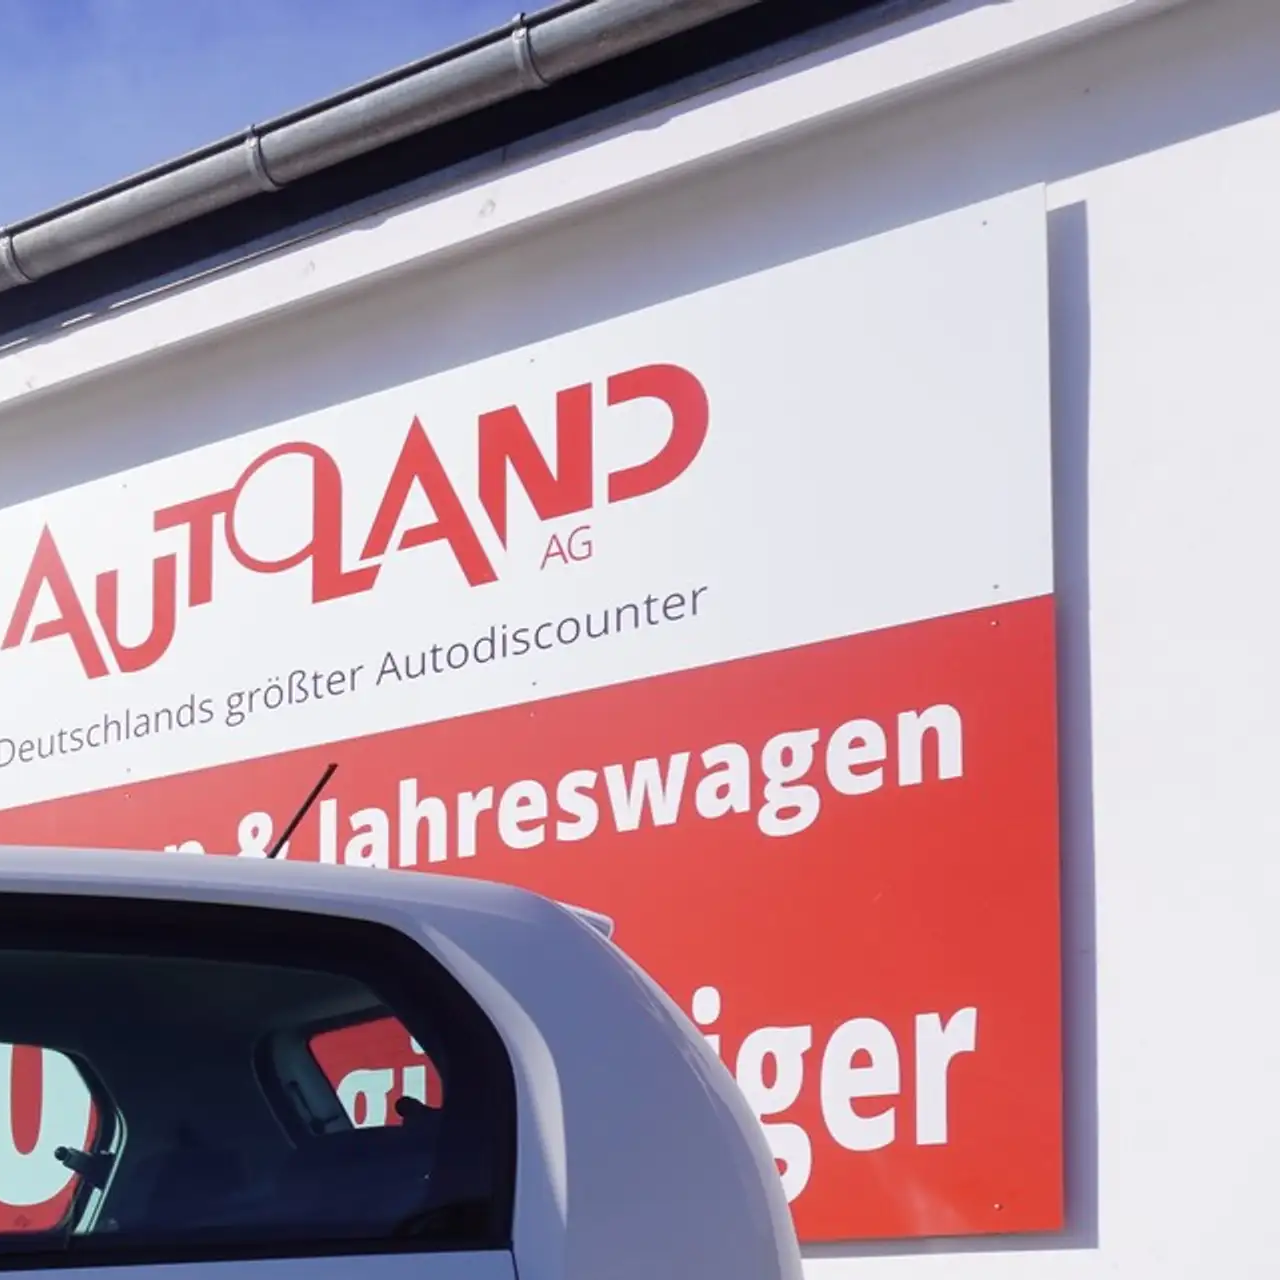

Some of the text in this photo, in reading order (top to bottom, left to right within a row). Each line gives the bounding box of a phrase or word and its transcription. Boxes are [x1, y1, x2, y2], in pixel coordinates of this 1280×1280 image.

[539, 524, 594, 571] AG
[224, 661, 365, 727] größter
[374, 584, 709, 686] Autodiscounter
[319, 702, 964, 870] Jahreswagen
